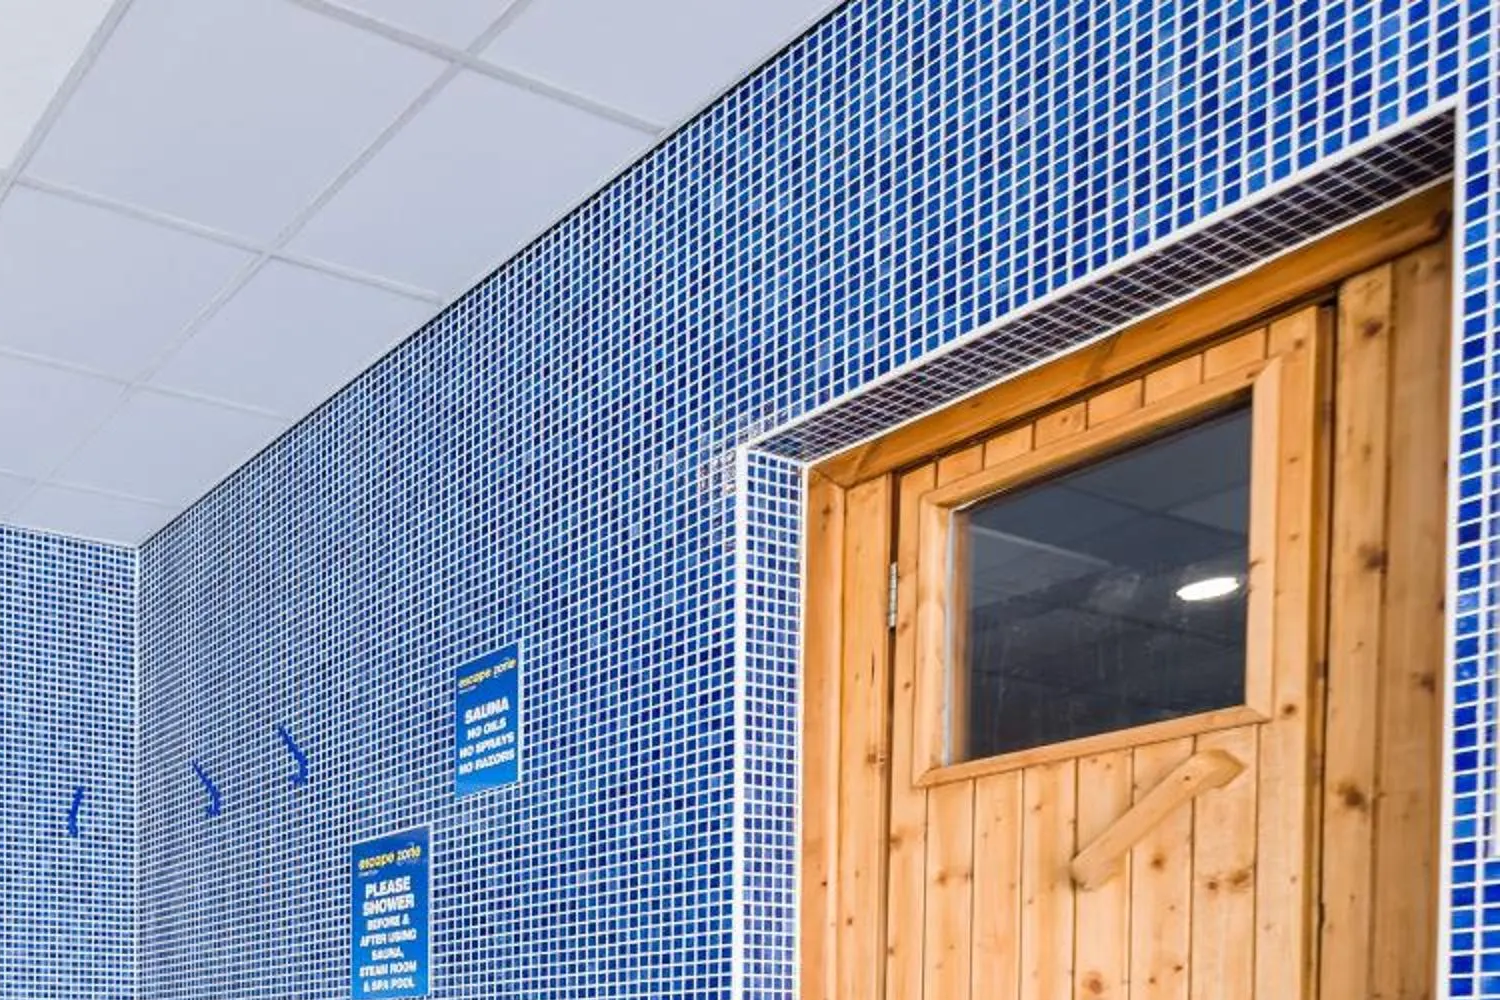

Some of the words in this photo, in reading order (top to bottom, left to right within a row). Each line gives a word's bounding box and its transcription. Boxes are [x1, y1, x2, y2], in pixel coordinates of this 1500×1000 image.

[464, 697, 509, 724] SAUNA
[467, 725, 482, 740] NO
[483, 717, 507, 735] OILS
[459, 745, 474, 759] NO
[475, 731, 515, 753] SPRAYS
[459, 761, 473, 775] NO
[475, 748, 515, 770] RAZORS
[365, 876, 411, 898] PLEASE
[363, 894, 415, 916] SHOWER
[367, 915, 400, 931] BEFORE
[402, 913, 410, 925] &
[360, 933, 387, 947] AFTER
[388, 929, 417, 945] USING
[359, 963, 388, 977] STEAM
[389, 960, 417, 975] ROOM
[371, 979, 389, 991] SPA
[390, 976, 416, 990] POOL
